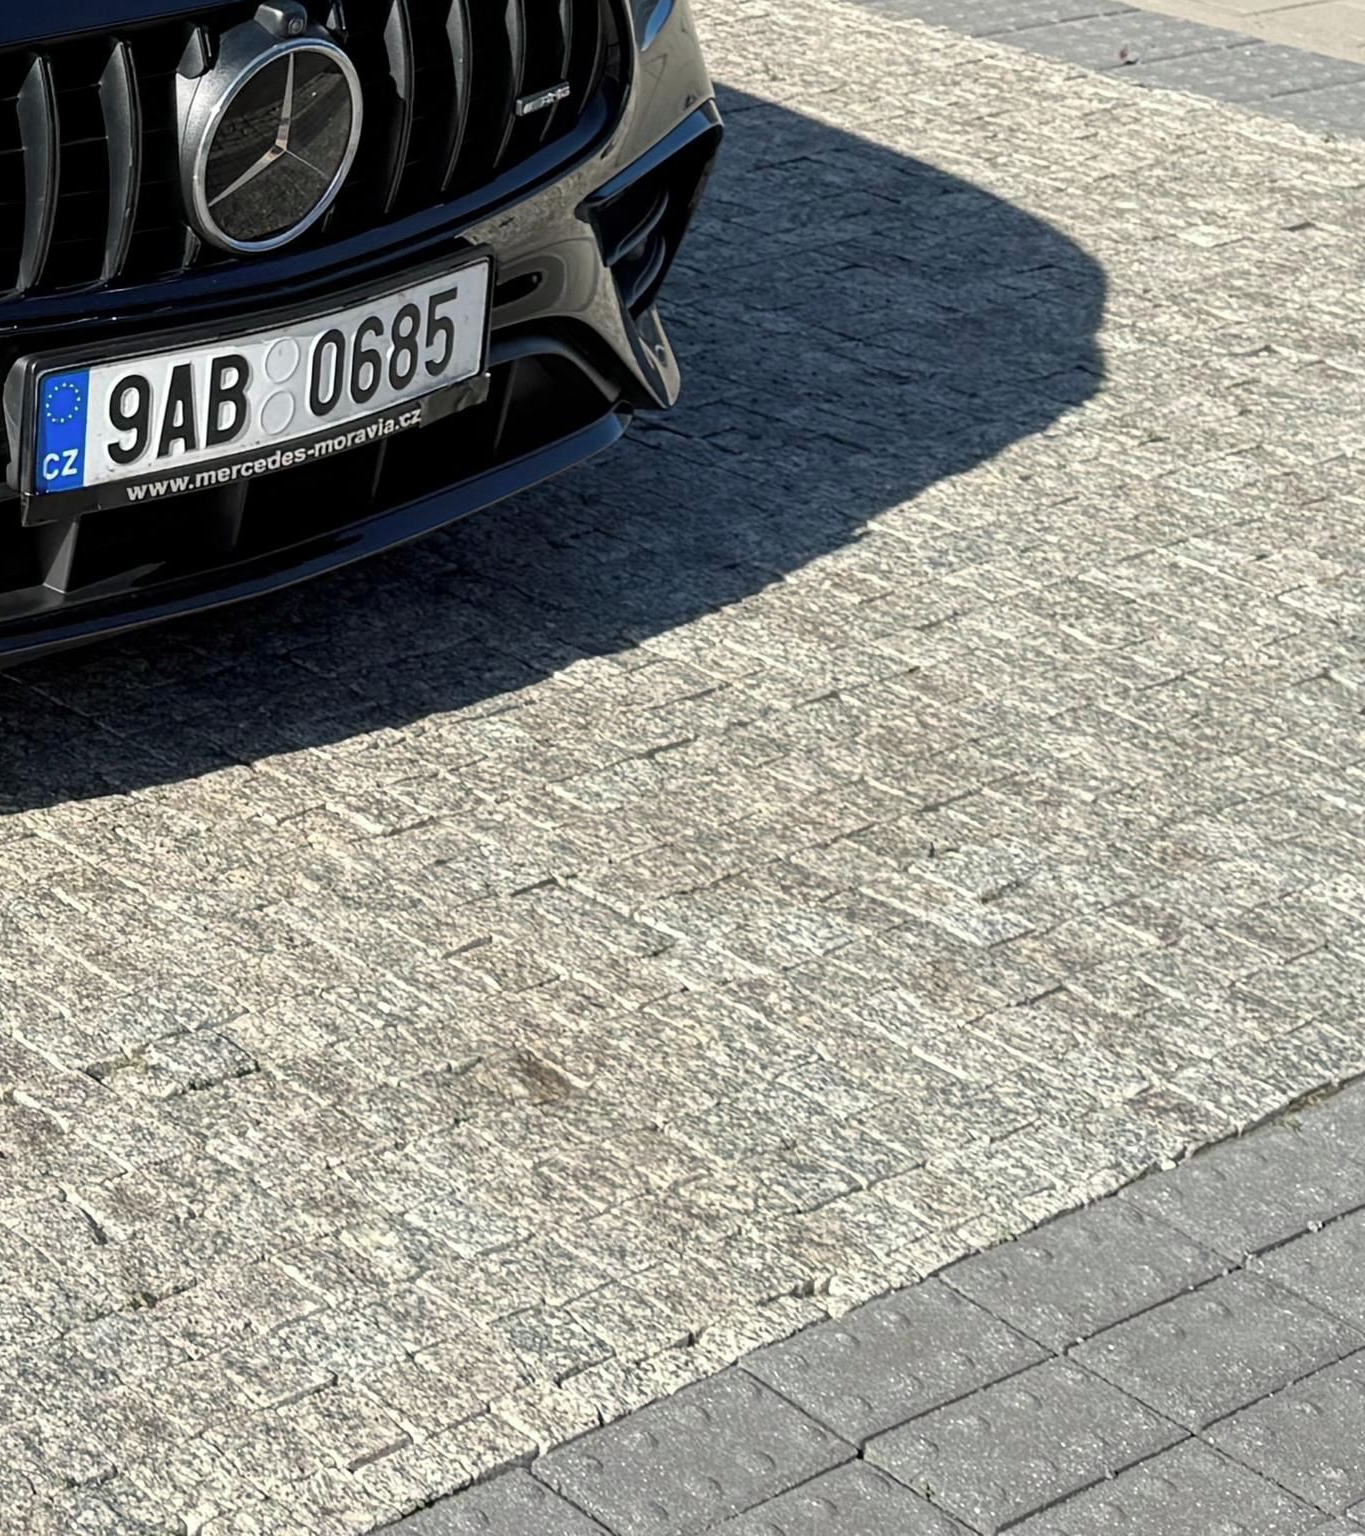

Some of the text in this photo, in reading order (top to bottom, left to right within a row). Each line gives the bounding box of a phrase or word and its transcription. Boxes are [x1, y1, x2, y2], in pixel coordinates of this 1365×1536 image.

[107, 288, 458, 465] 9AB 0685
[44, 448, 78, 481] CZ
[127, 408, 422, 502] www.mercedes-moravia.cz
